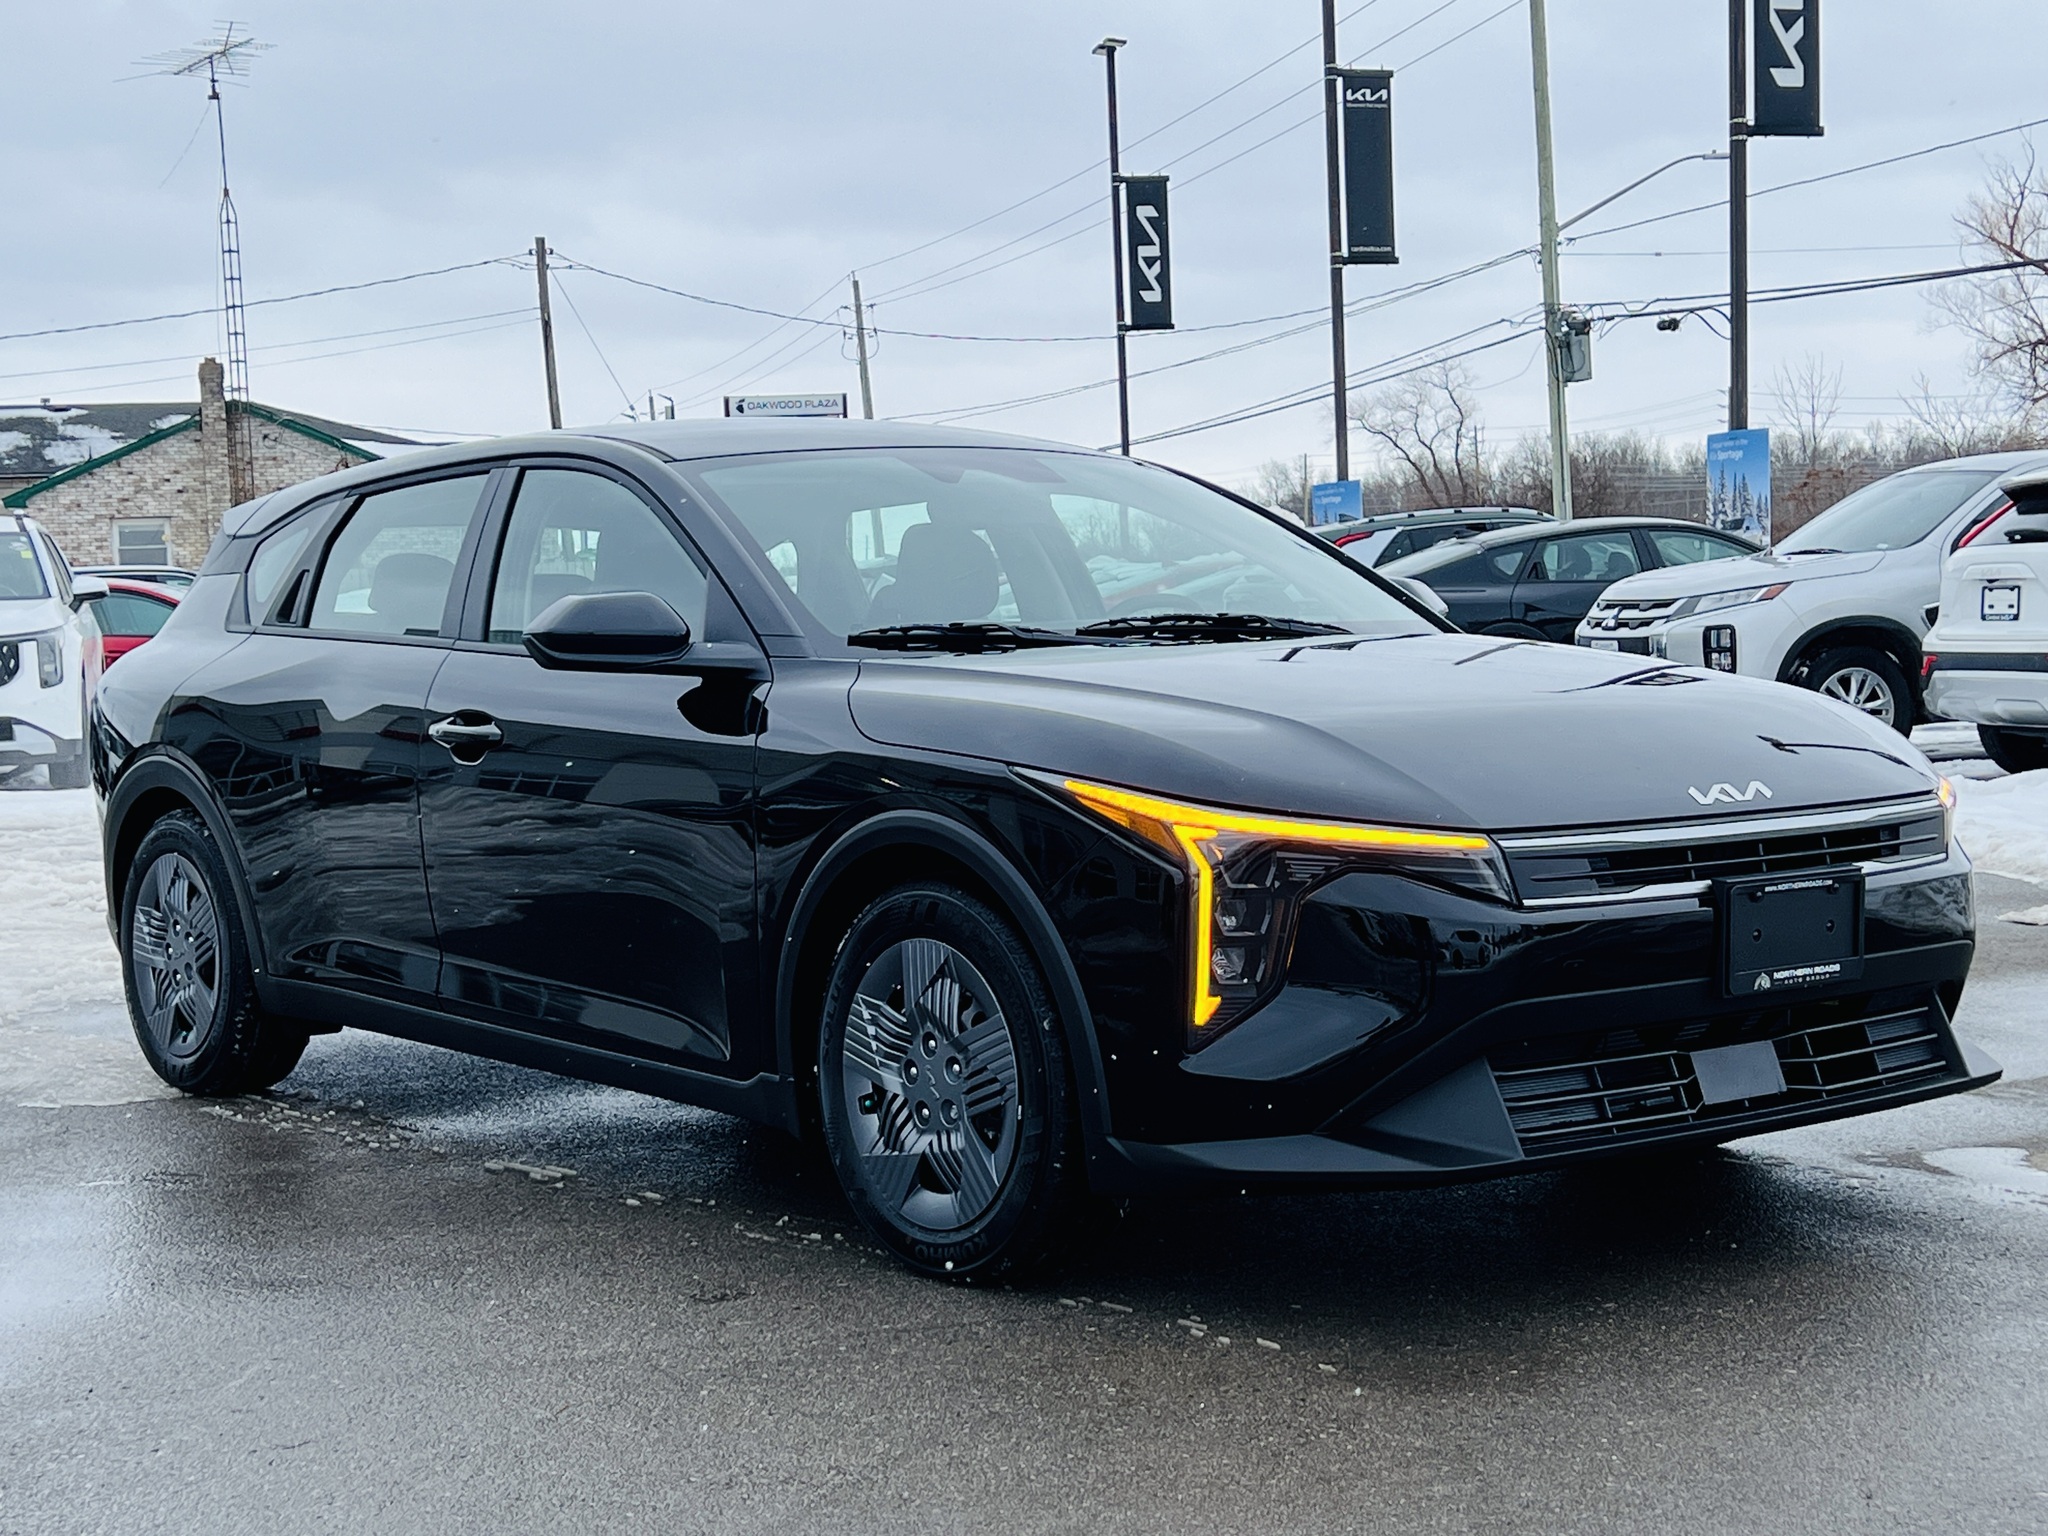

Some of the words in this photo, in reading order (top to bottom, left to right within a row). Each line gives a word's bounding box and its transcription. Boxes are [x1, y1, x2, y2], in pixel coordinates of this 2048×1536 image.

[1345, 88, 1388, 102] KIA
[1135, 204, 1163, 303] KIA
[747, 400, 803, 411] OAKWOOD
[804, 399, 839, 409] PLAZA
[1687, 780, 1773, 806] KIA
[1773, 967, 1814, 980] NORTHERN
[1813, 963, 1841, 974] ROADS
[913, 1231, 991, 1263] KUMHO
